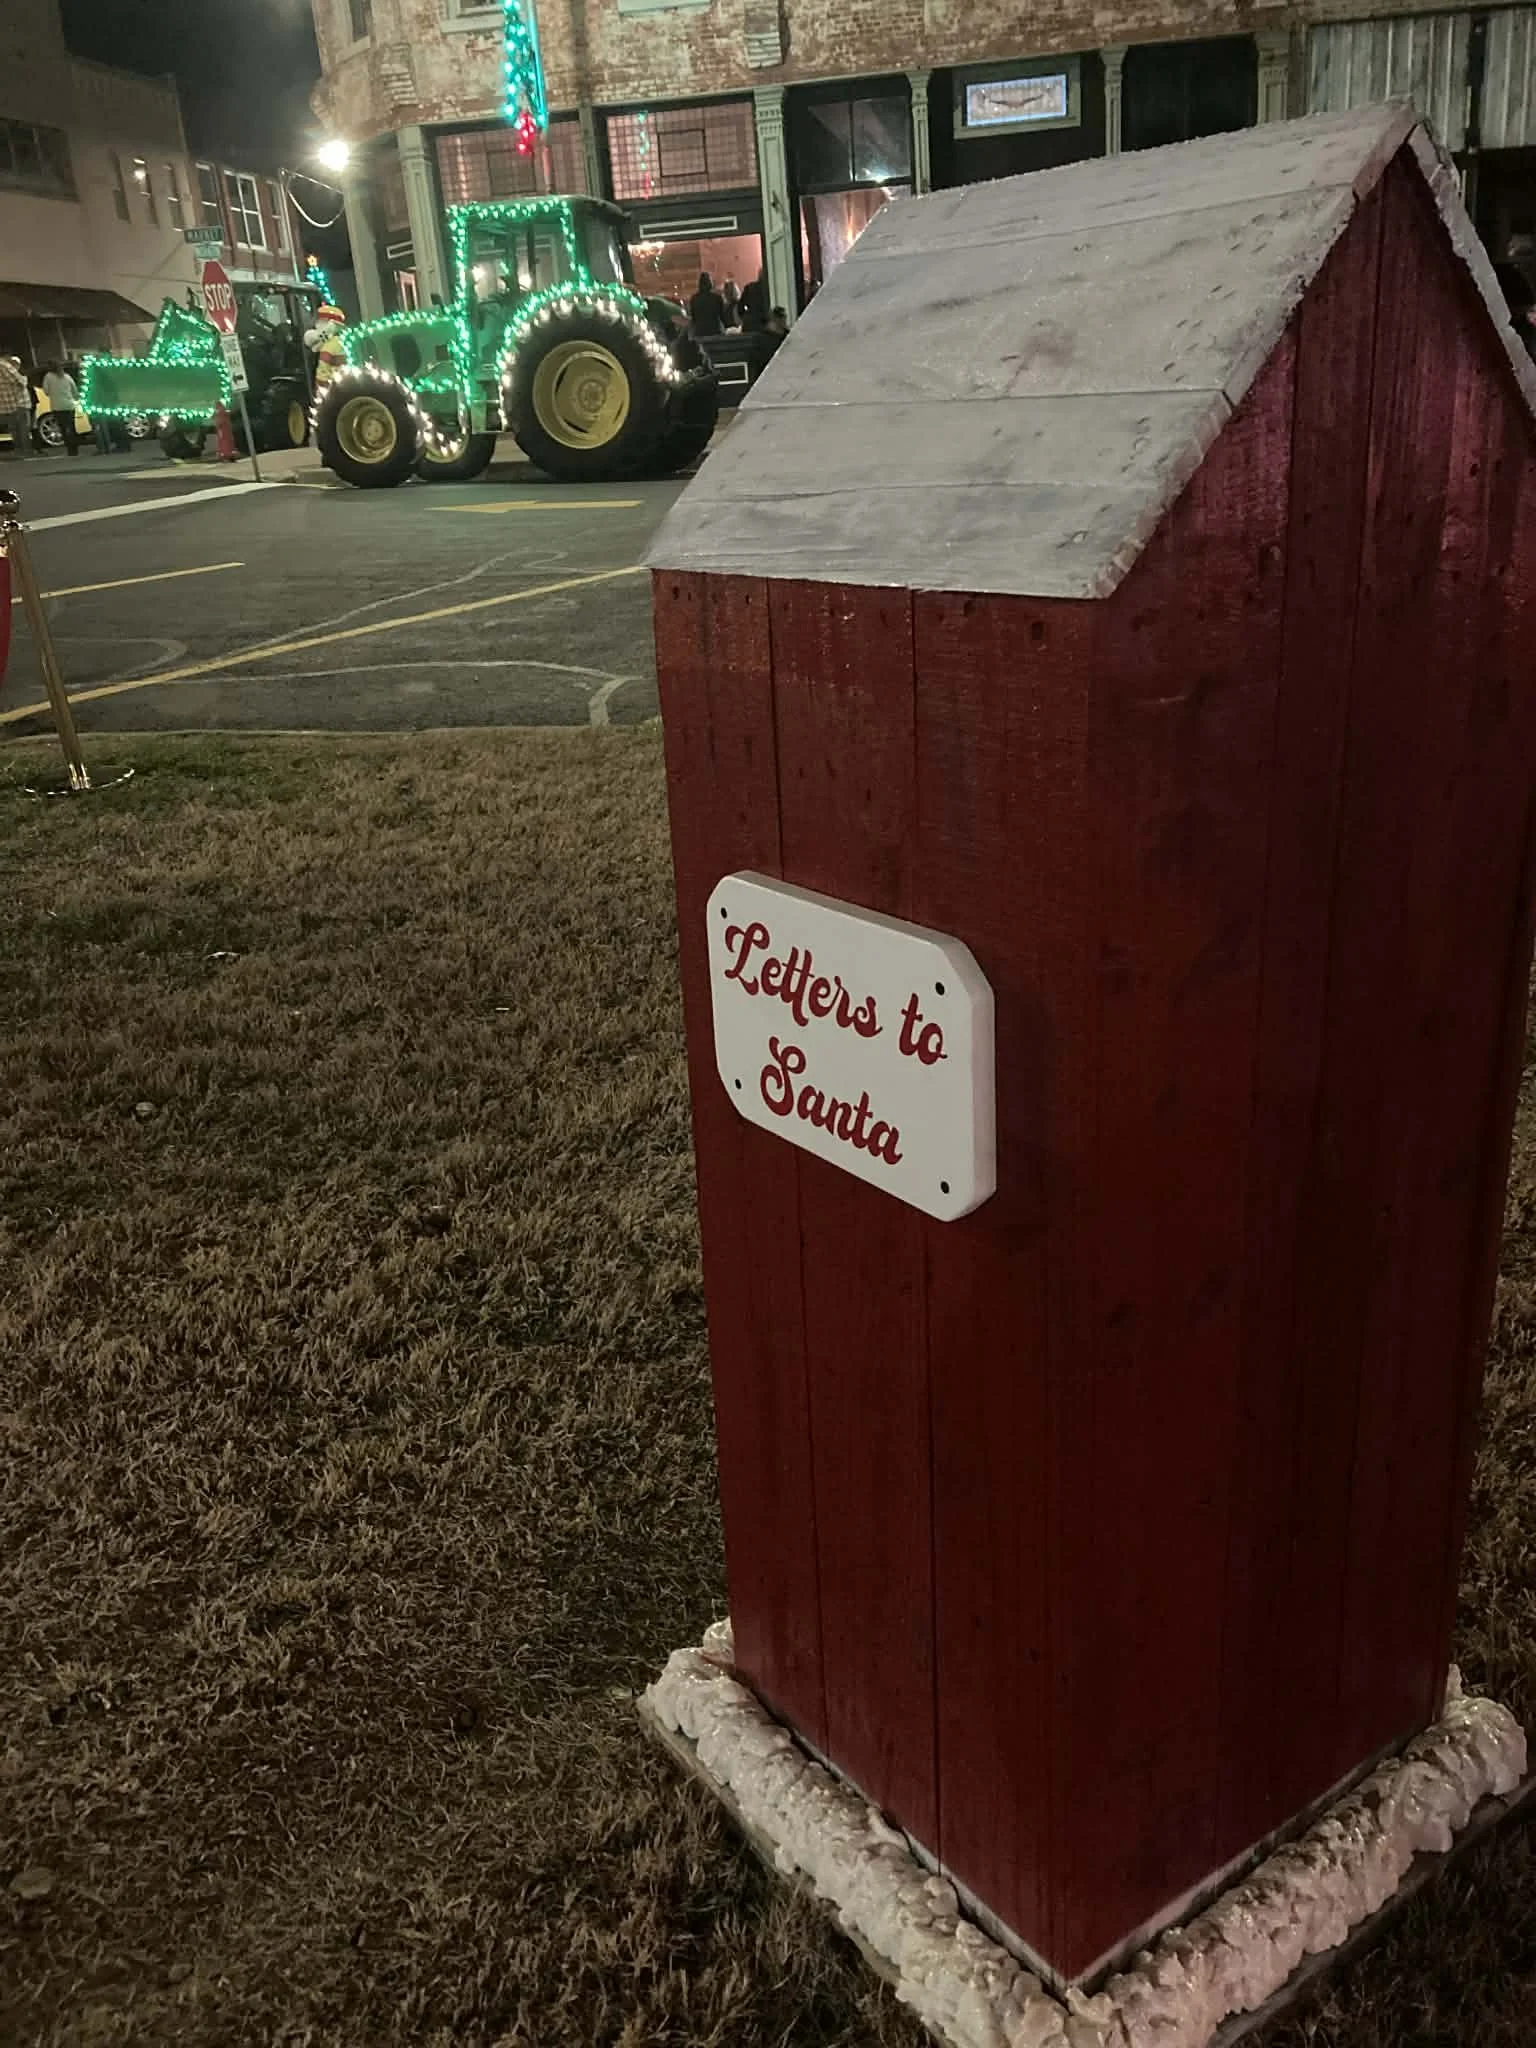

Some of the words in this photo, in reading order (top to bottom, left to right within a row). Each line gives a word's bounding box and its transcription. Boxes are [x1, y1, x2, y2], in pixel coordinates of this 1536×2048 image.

[205, 285, 232, 311] STOP
[724, 922, 883, 1037] Letters
[899, 993, 948, 1065] to
[760, 1036, 903, 1165] Santa
